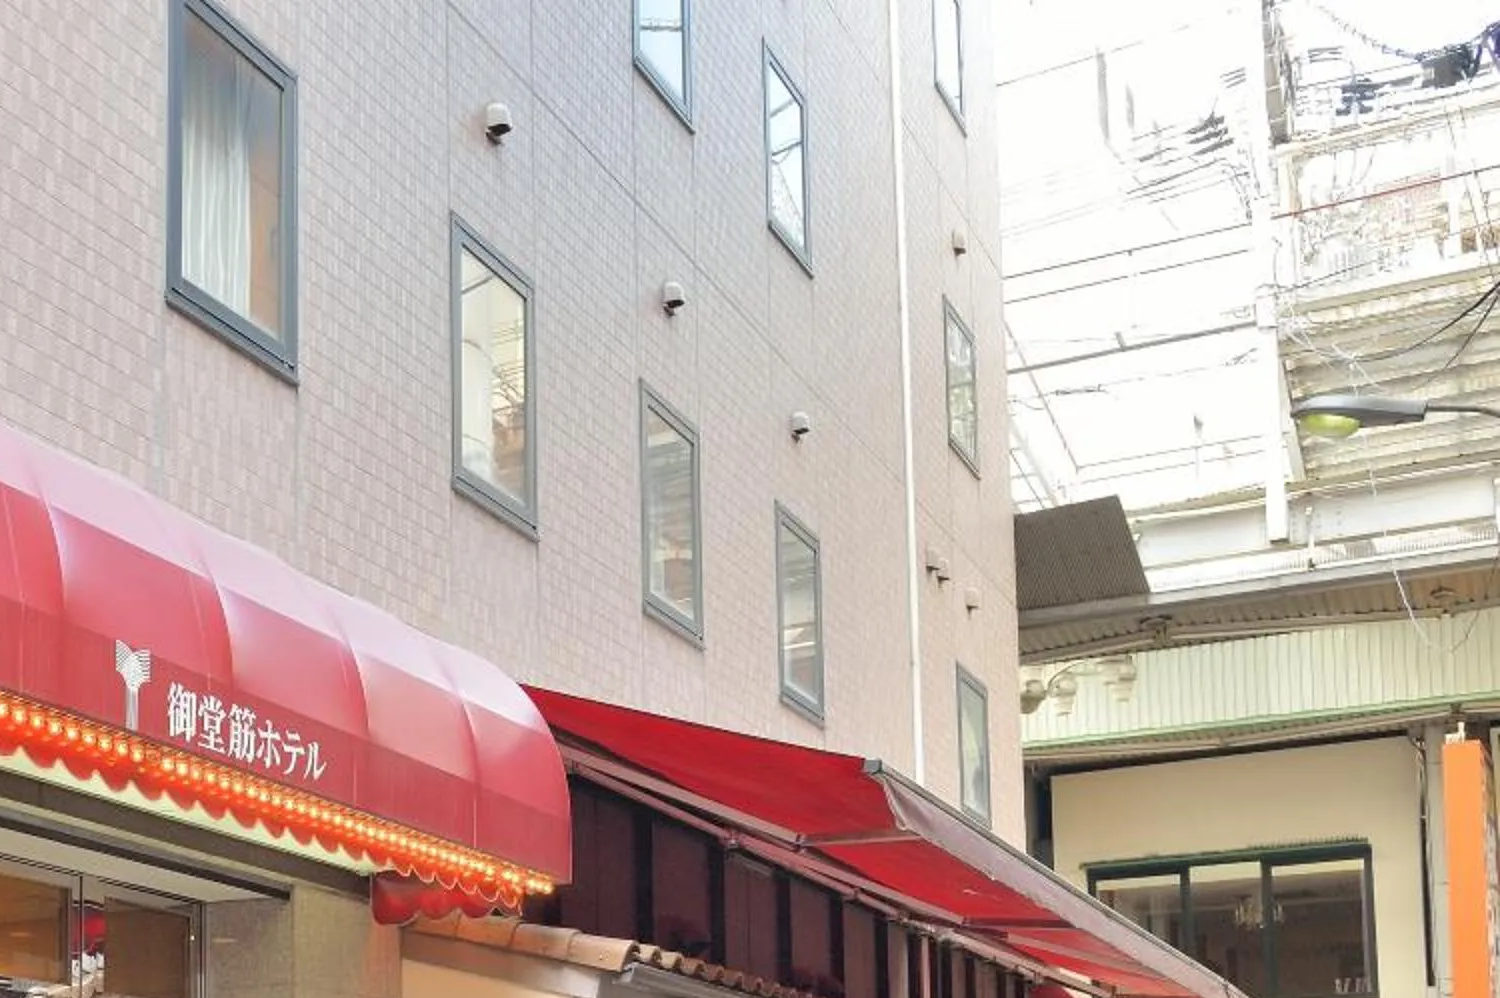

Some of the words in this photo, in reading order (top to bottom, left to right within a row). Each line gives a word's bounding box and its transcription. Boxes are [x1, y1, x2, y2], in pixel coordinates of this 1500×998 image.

[166, 681, 326, 781] 御堂筋ホテル
